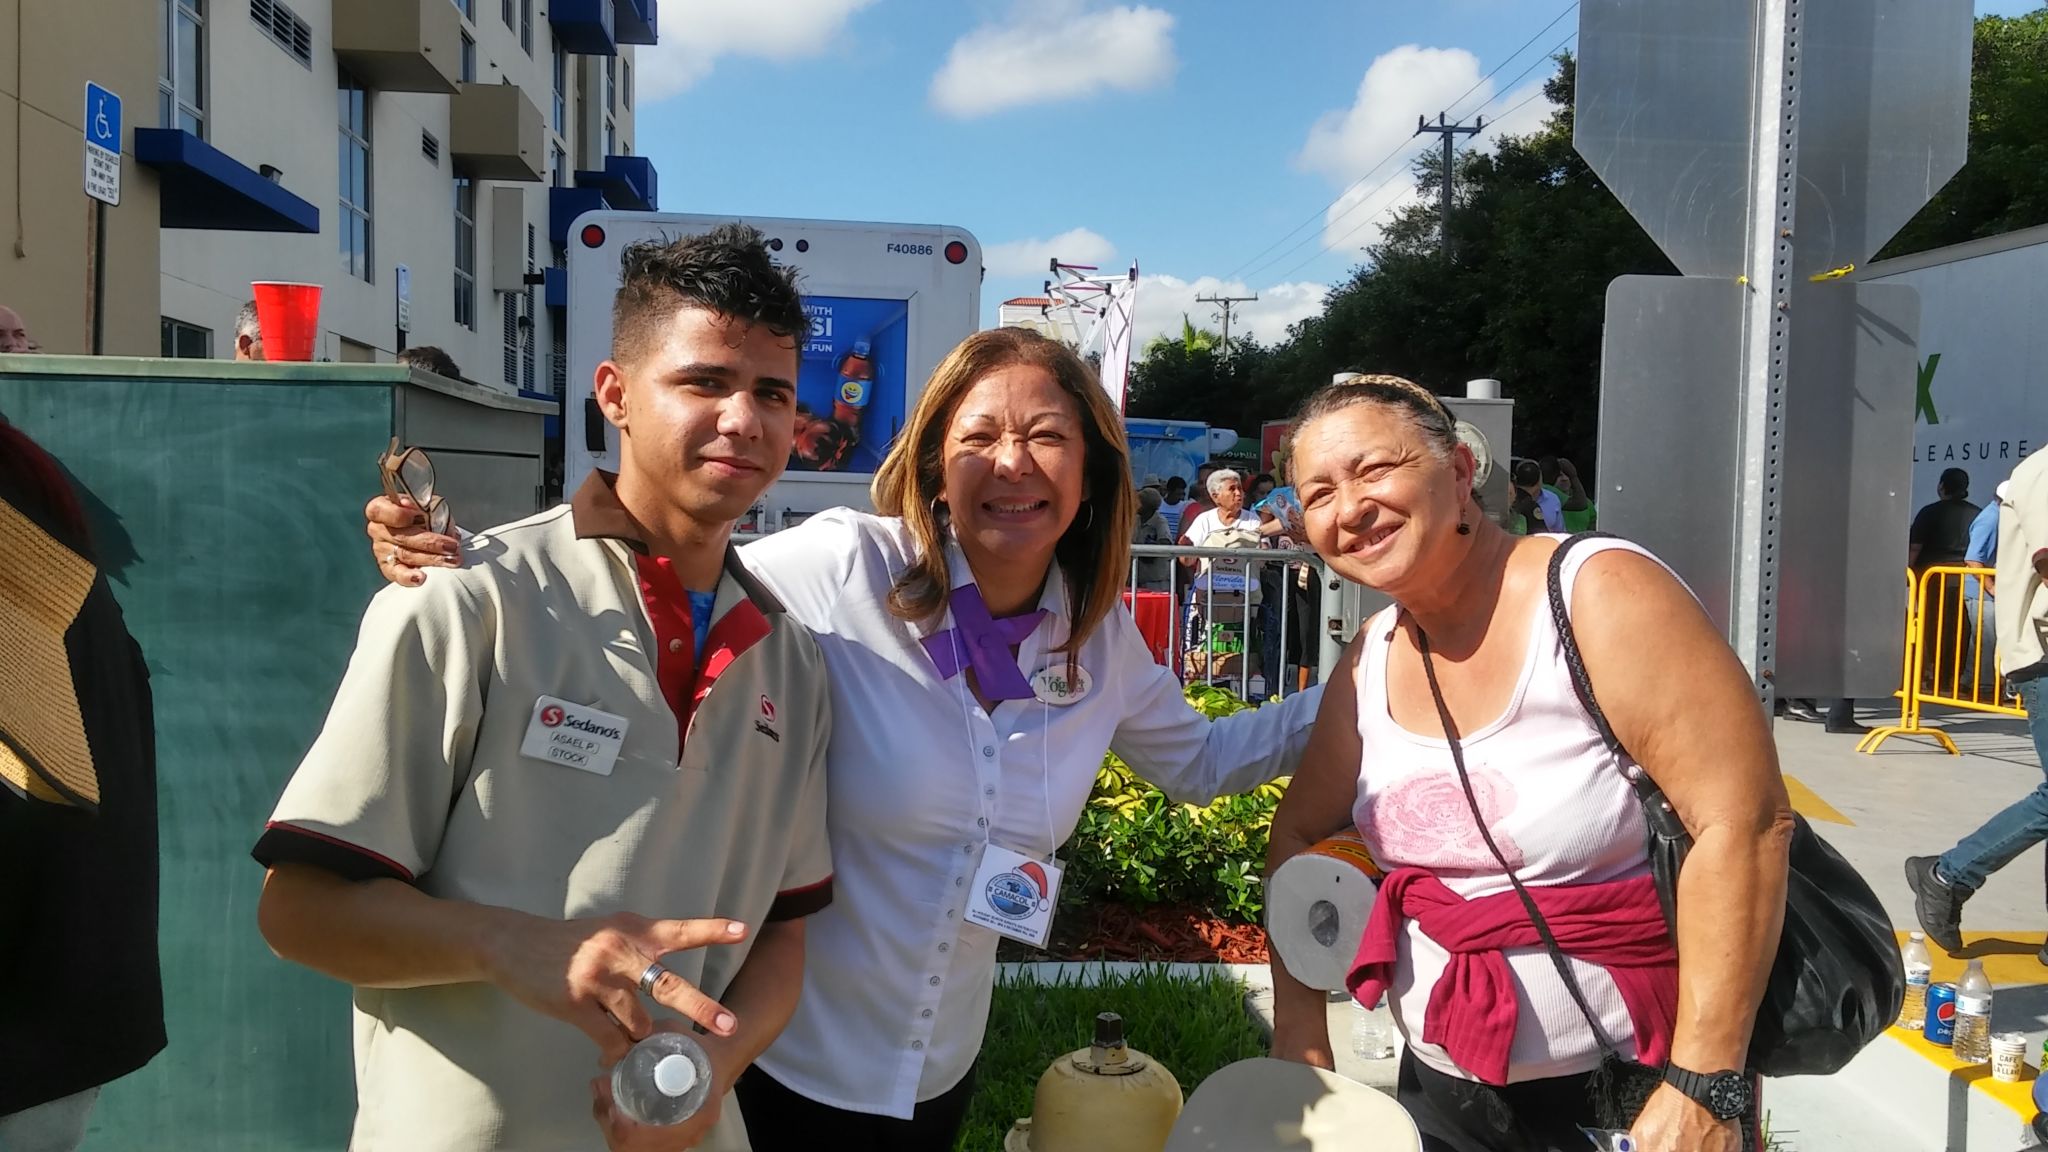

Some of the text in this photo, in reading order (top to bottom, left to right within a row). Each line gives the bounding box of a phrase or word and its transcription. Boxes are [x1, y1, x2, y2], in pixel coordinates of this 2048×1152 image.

[887, 243, 933, 256] F40886
[811, 343, 833, 353] FUN
[1913, 440, 2028, 462] LEASURE
[553, 733, 583, 749] ASAEL
[551, 748, 584, 764] STOCK
[994, 887, 1030, 906] CAMACOL
[1937, 1028, 1955, 1037] pep
